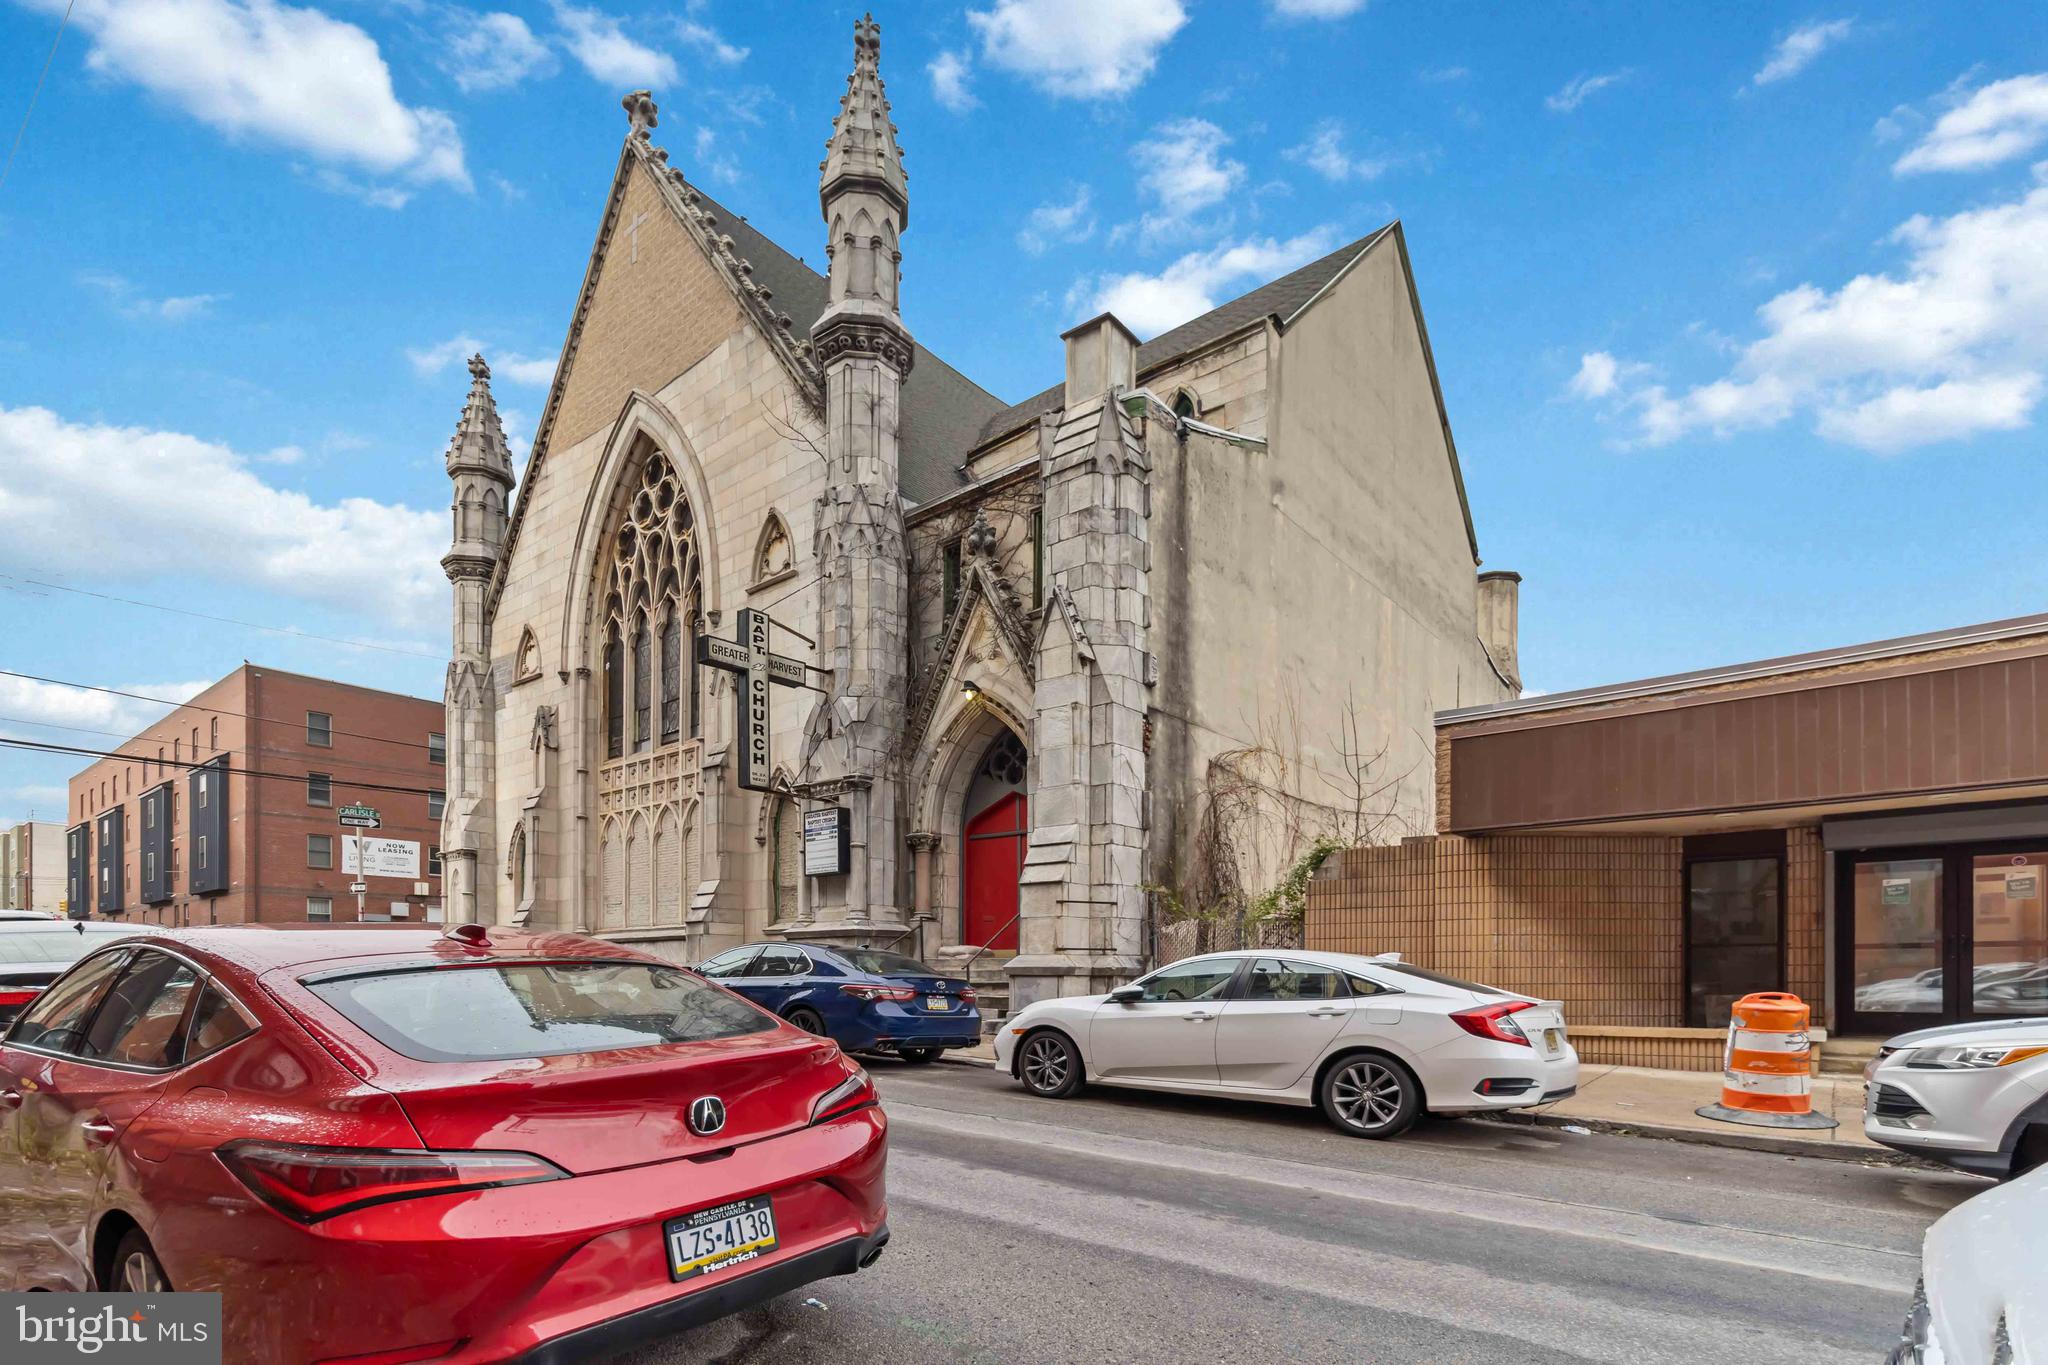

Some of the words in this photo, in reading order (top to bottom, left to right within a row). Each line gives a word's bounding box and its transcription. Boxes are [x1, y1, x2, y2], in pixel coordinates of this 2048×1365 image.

[752, 613, 766, 656] BAPT.
[711, 643, 750, 663] GREATER
[767, 659, 802, 677] HARVEST
[752, 679, 765, 766] CHURCH
[340, 808, 375, 818] CARLISLE
[693, 1211, 709, 1219] NEW
[694, 1206, 746, 1226] PENNSYLVANIA
[703, 1250, 758, 1274] Hertrich
